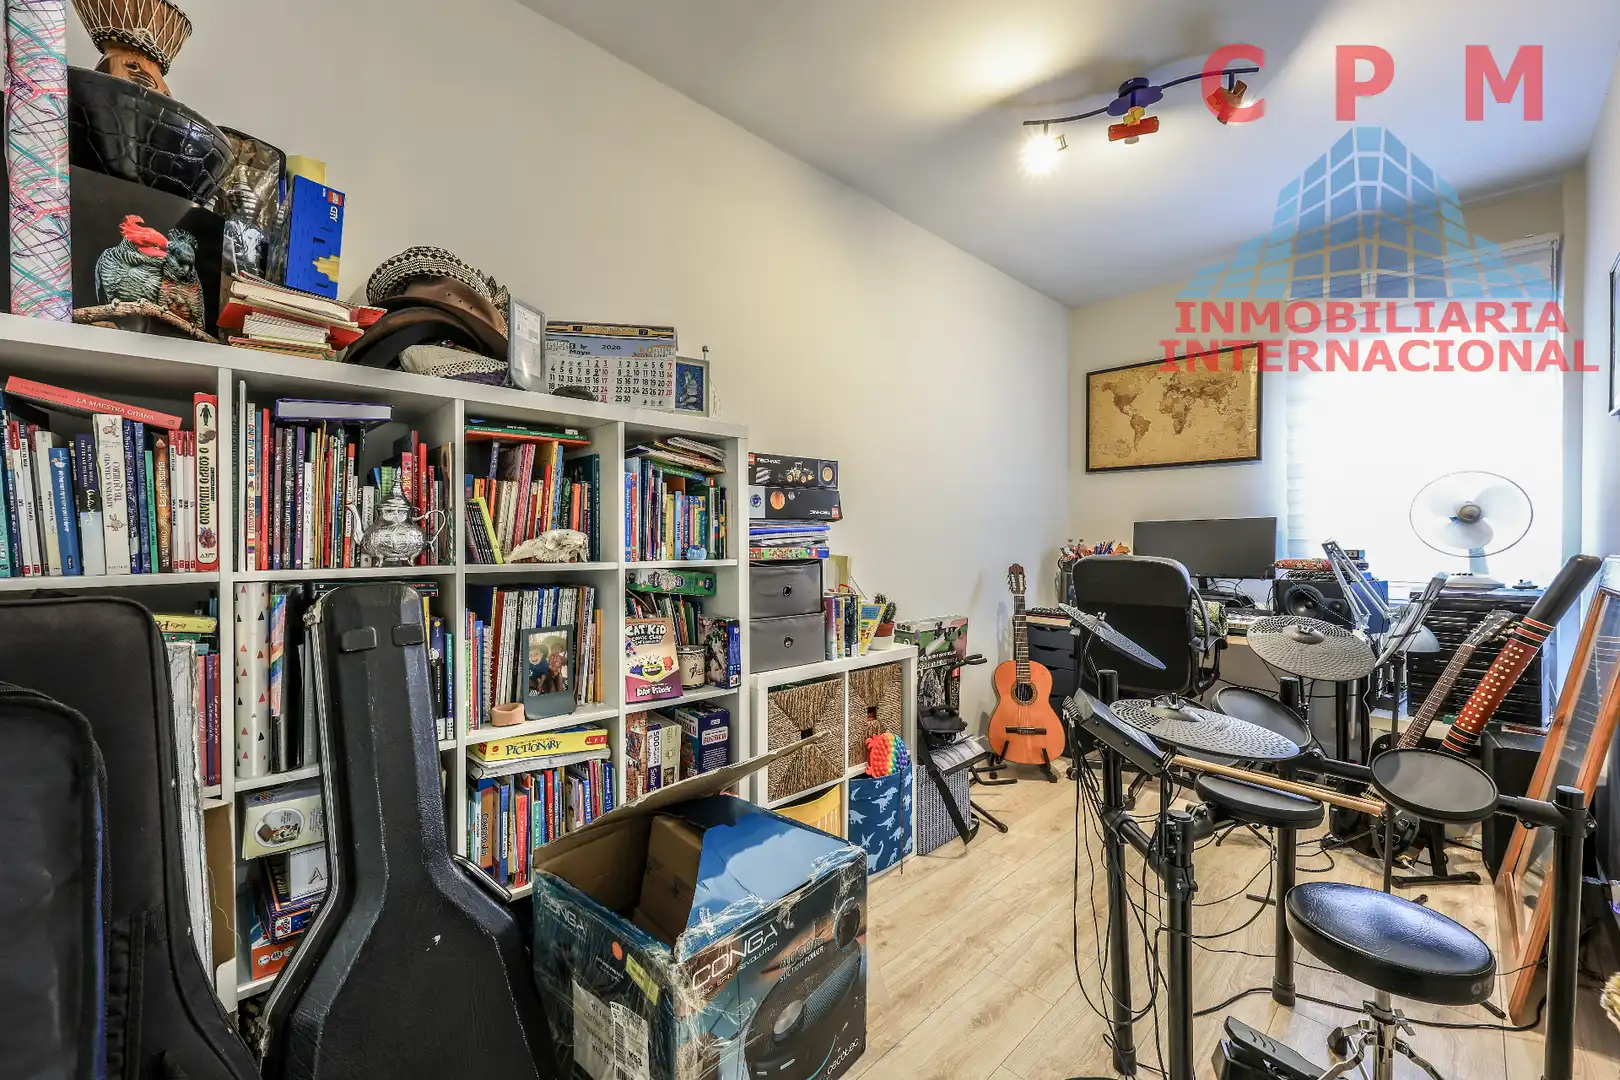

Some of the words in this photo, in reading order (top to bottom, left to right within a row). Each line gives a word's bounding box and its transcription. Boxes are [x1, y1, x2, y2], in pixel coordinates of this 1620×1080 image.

[330, 206, 339, 222] CITY
[76, 397, 87, 405] LA
[88, 400, 125, 414] MAESTRA
[126, 408, 156, 421] GITANA
[112, 461, 122, 491] QUIERO
[158, 461, 167, 497] prehistoria
[199, 456, 209, 484] CORPO
[114, 492, 122, 502] TE
[158, 498, 166, 507] La
[199, 486, 210, 525] HUMANO
[625, 624, 646, 636] CAT
[506, 739, 562, 755] PICTIONARY
[692, 924, 778, 991] CONGA
[737, 941, 778, 971] REVOLUTION
[779, 958, 805, 983] SUCTION
[805, 945, 825, 966] POWER
